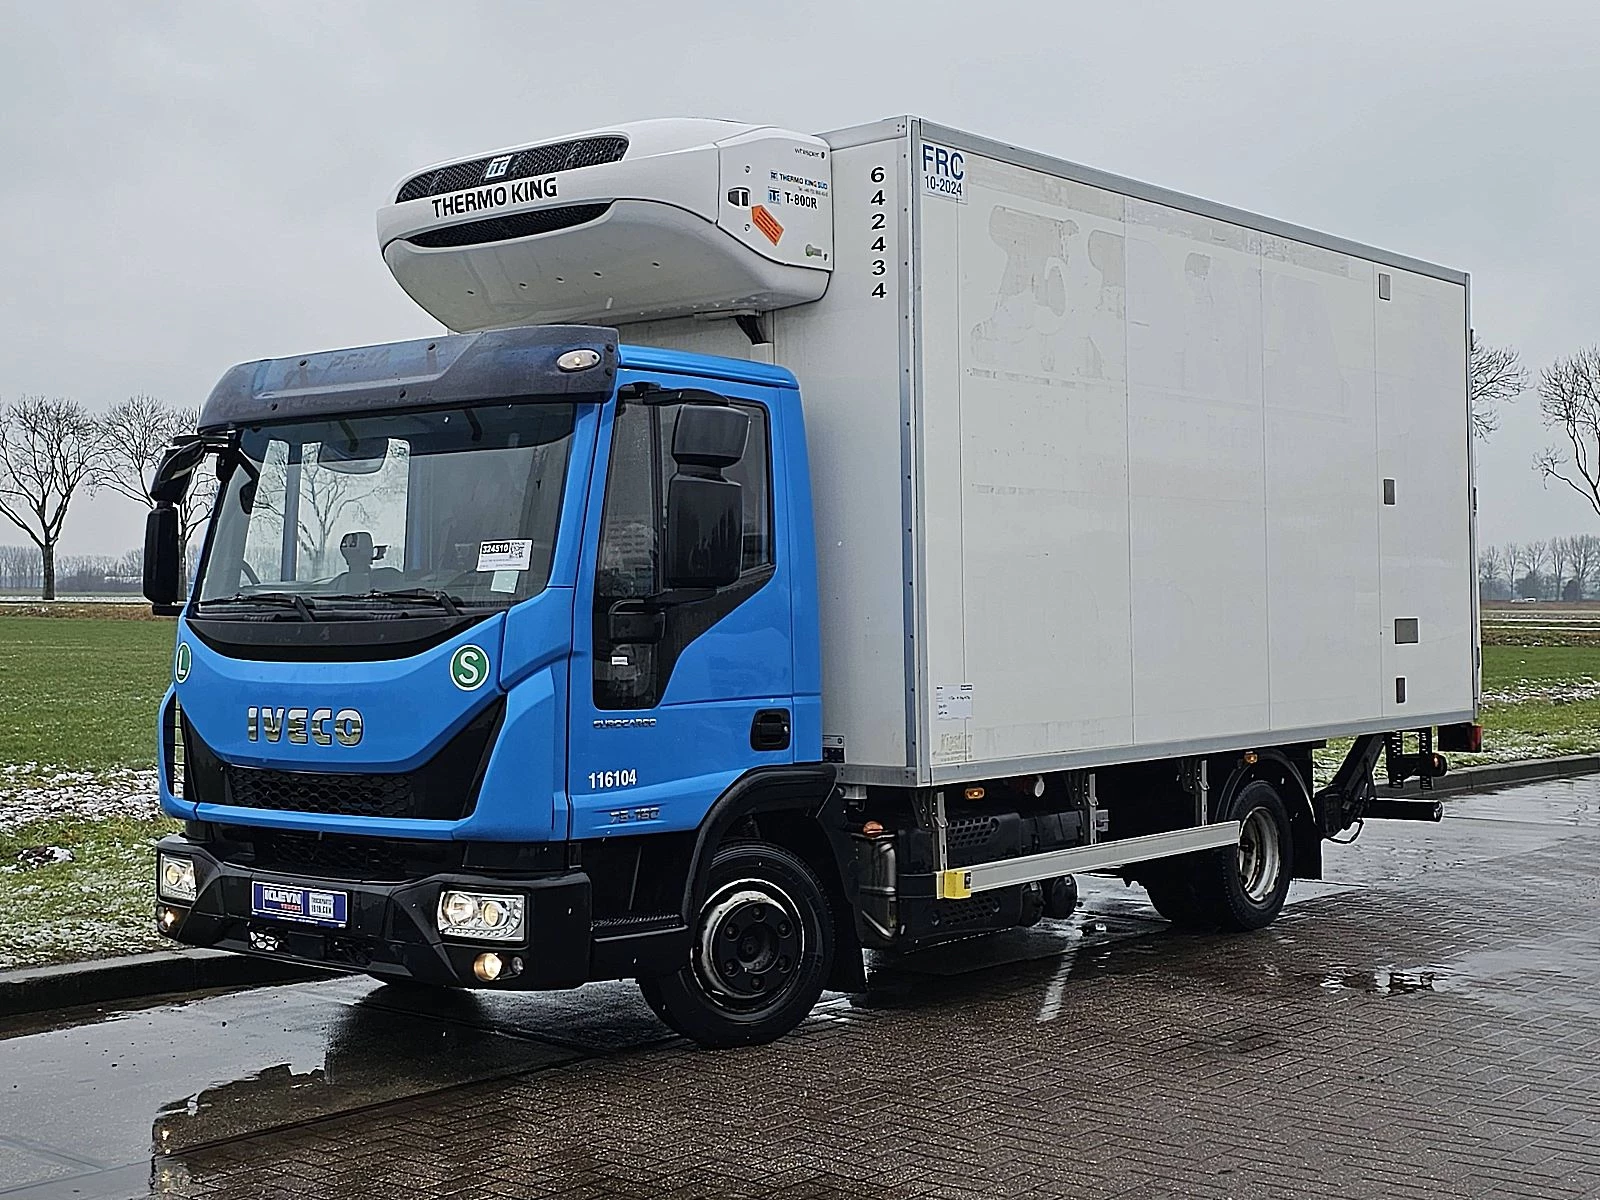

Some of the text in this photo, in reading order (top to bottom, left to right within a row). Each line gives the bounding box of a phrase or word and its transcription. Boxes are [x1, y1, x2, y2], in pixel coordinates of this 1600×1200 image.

[923, 144, 964, 180] FRC
[779, 173, 804, 184] THERMO
[804, 179, 817, 188] KING
[925, 175, 962, 196] 10-2024
[432, 177, 557, 218] THERMO KING
[784, 191, 818, 209] T-800R
[482, 544, 509, 554] 324510
[176, 648, 187, 677] L
[458, 651, 480, 684] S
[248, 706, 364, 747] IVECO
[593, 719, 657, 729] EUROCARGO
[588, 768, 637, 789] 116104
